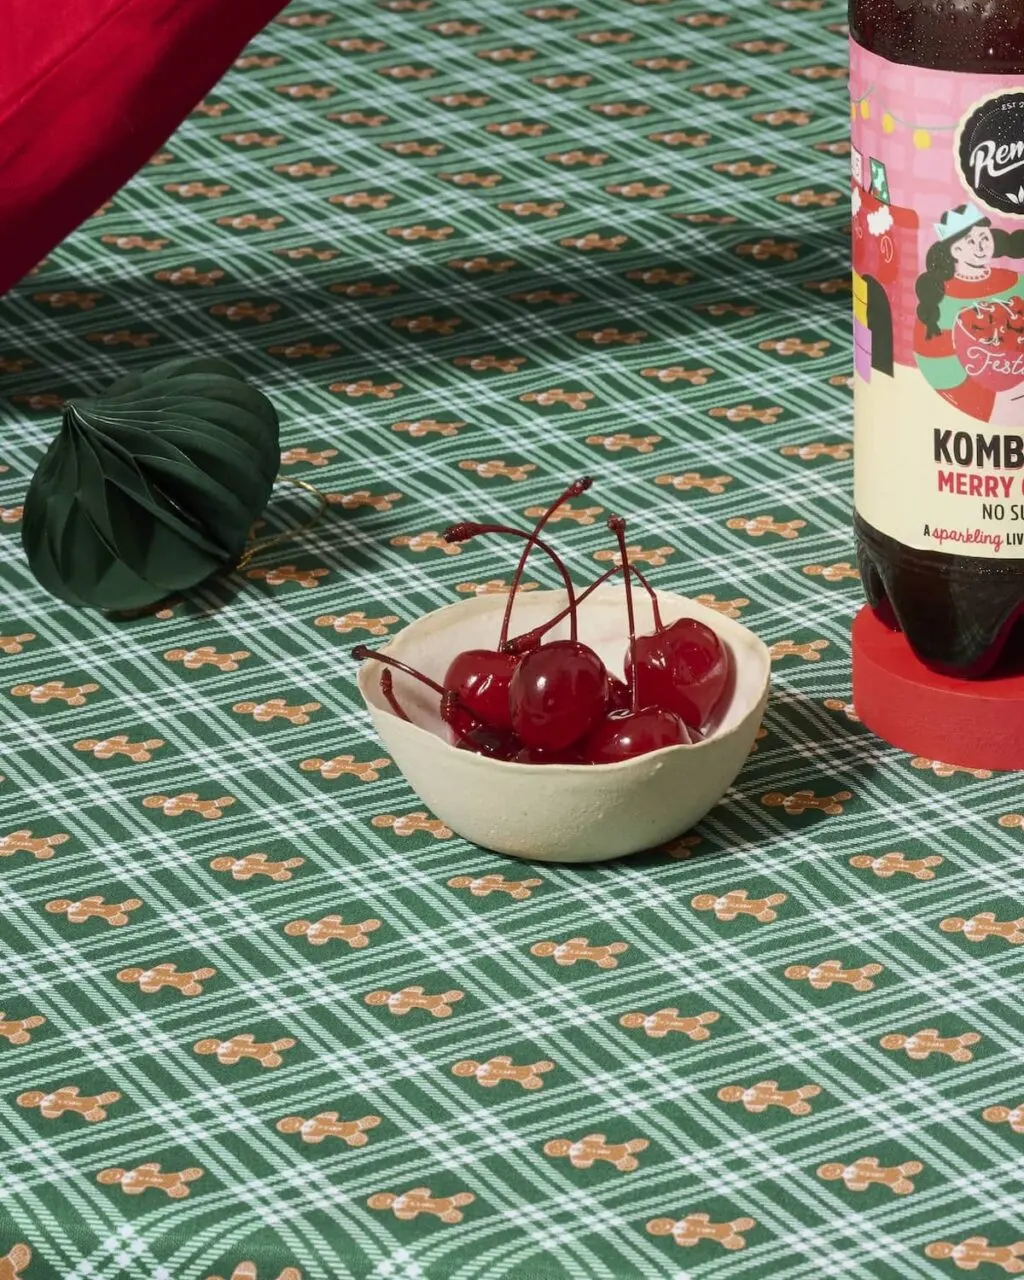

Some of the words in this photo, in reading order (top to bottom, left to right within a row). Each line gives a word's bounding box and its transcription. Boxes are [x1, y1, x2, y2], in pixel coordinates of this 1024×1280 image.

[1001, 102, 1016, 111] EST
[937, 470, 1014, 498] MERRY
[982, 504, 1005, 520] NO
[923, 524, 930, 537] A
[932, 527, 1003, 552] sparkling
